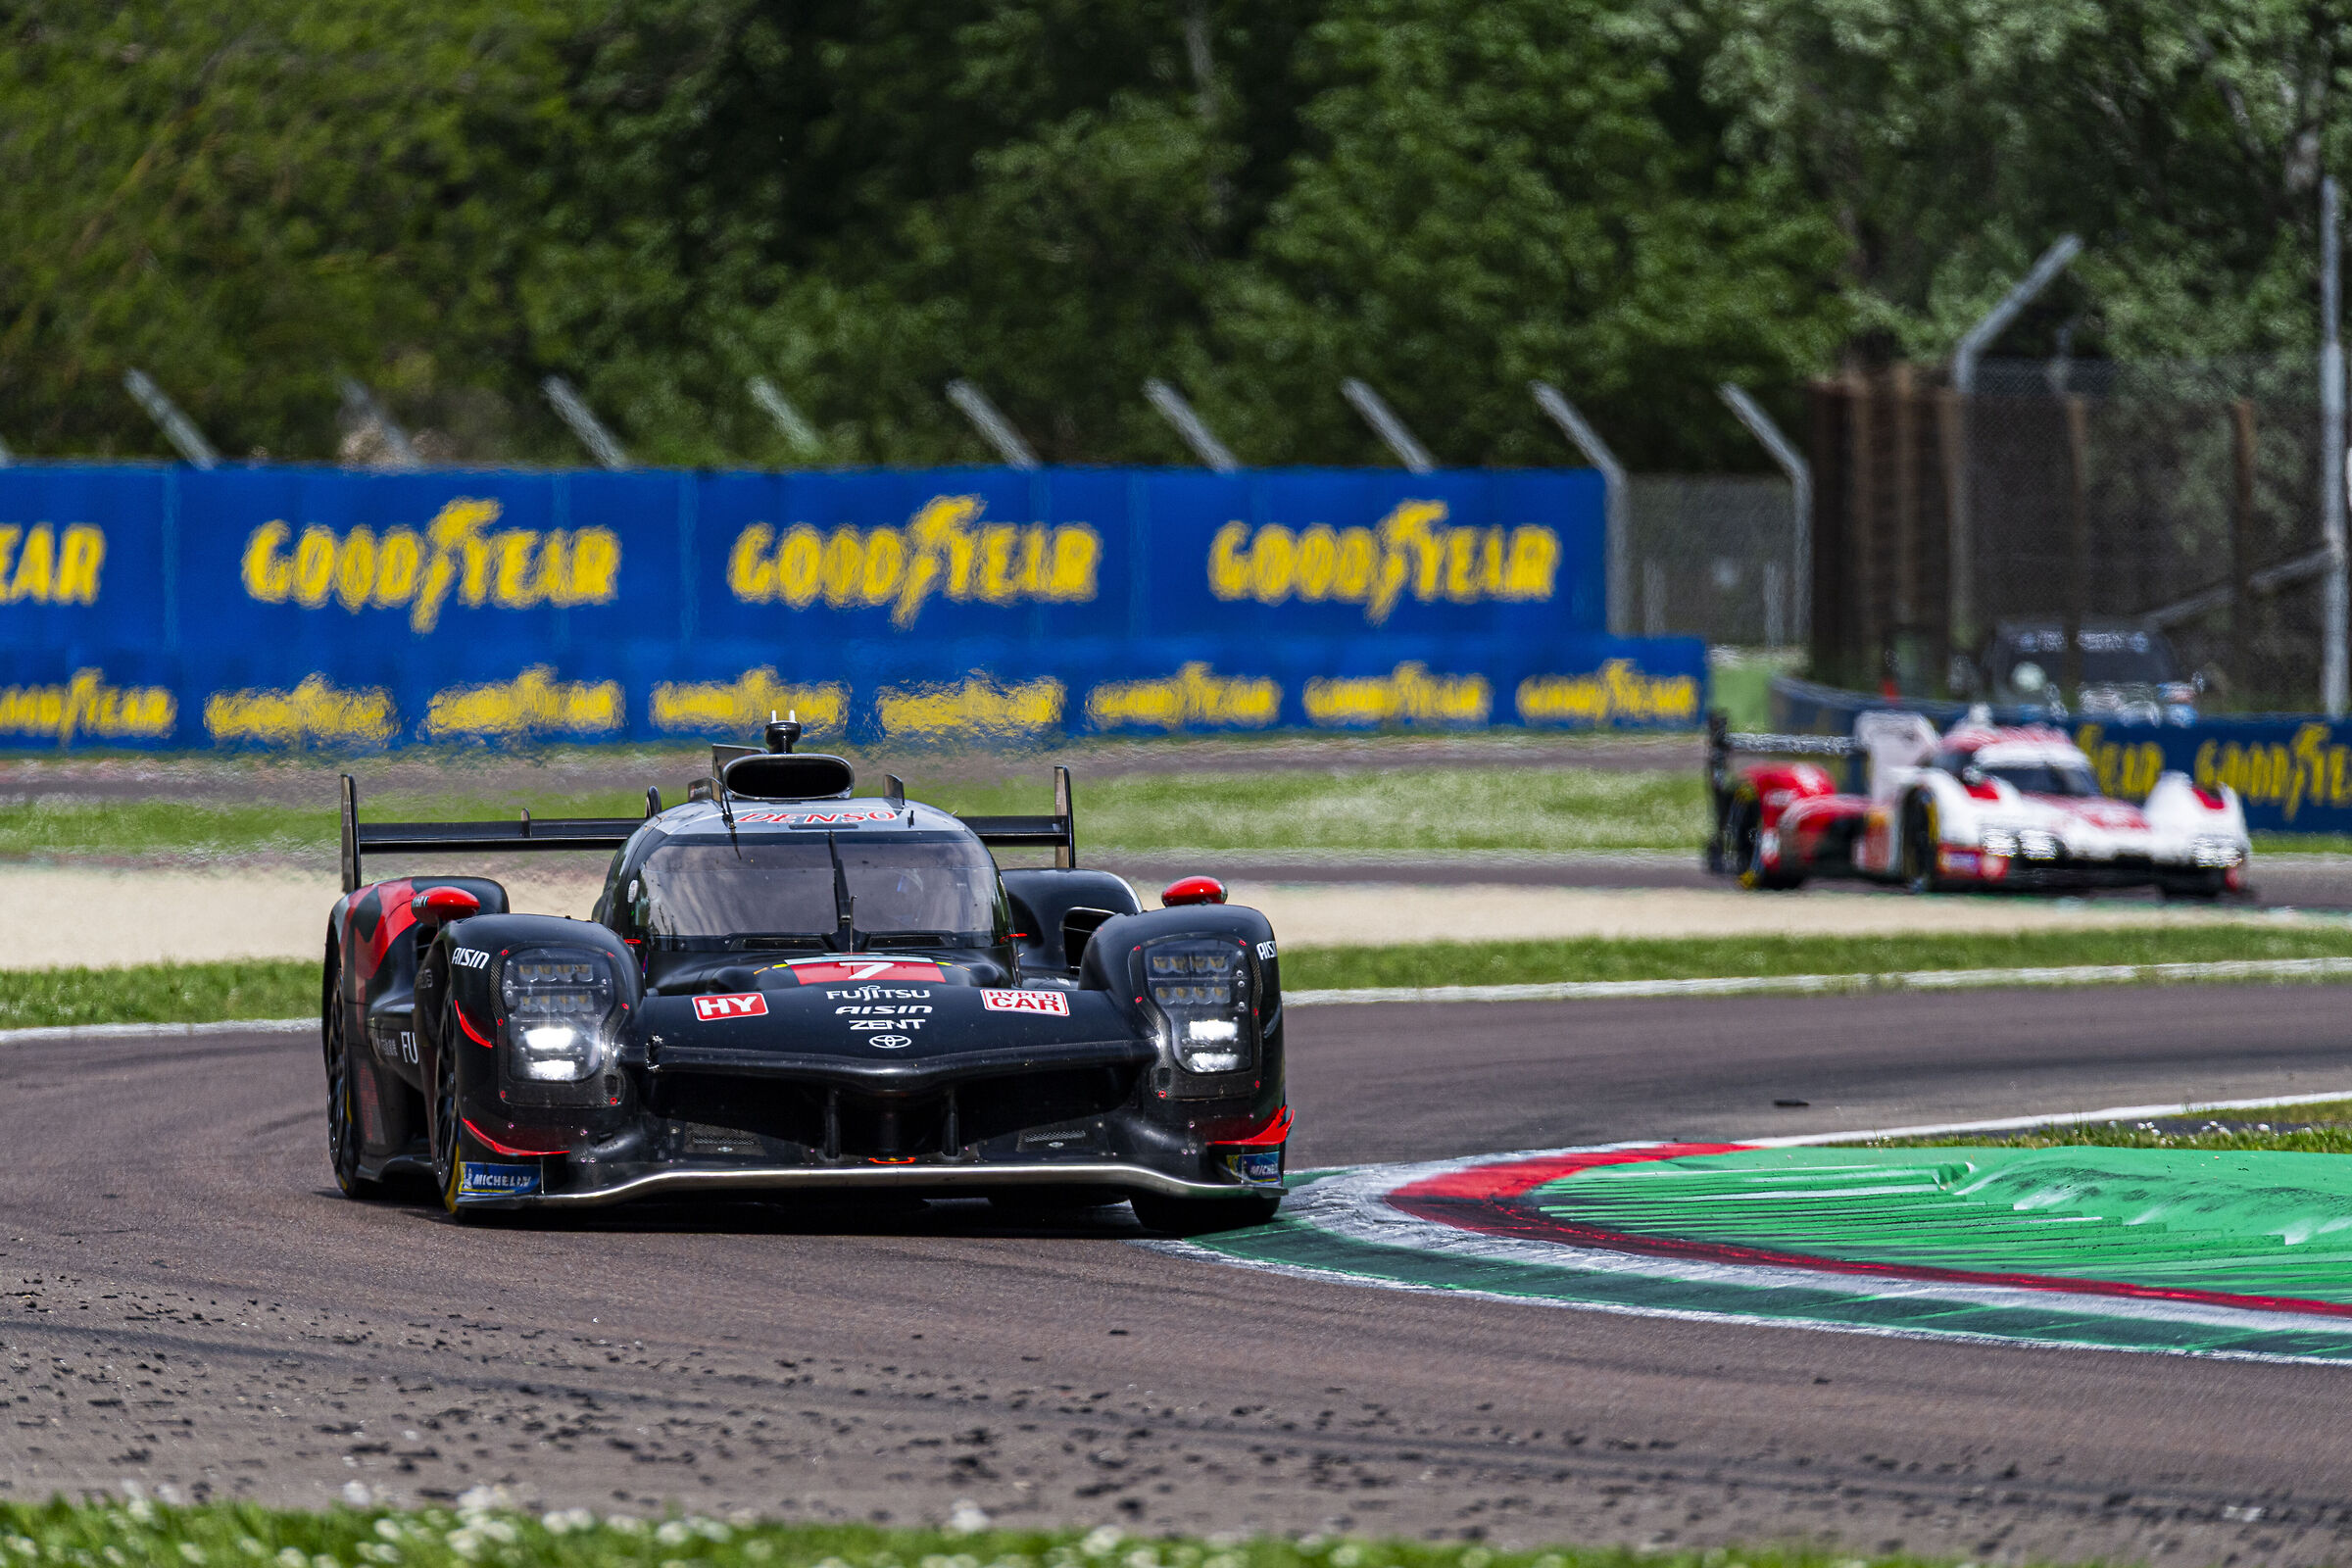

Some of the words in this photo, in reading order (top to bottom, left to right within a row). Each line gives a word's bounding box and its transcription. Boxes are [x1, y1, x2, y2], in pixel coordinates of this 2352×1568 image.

[241, 496, 623, 633] GOODYEAR
[726, 493, 1103, 630] GOODYEAR
[1207, 499, 1561, 626] GOODYEAR
[735, 809, 899, 824] DENSO
[451, 947, 490, 969] AISIN
[838, 961, 895, 980] 7
[825, 985, 931, 1002] FUJITSU
[988, 991, 1058, 1000] HYPER
[698, 996, 758, 1016] HY
[835, 1005, 933, 1014] AISIN
[991, 997, 1060, 1011] CAR
[849, 1019, 926, 1030] ZENT
[472, 1174, 531, 1187] MICHELIN
